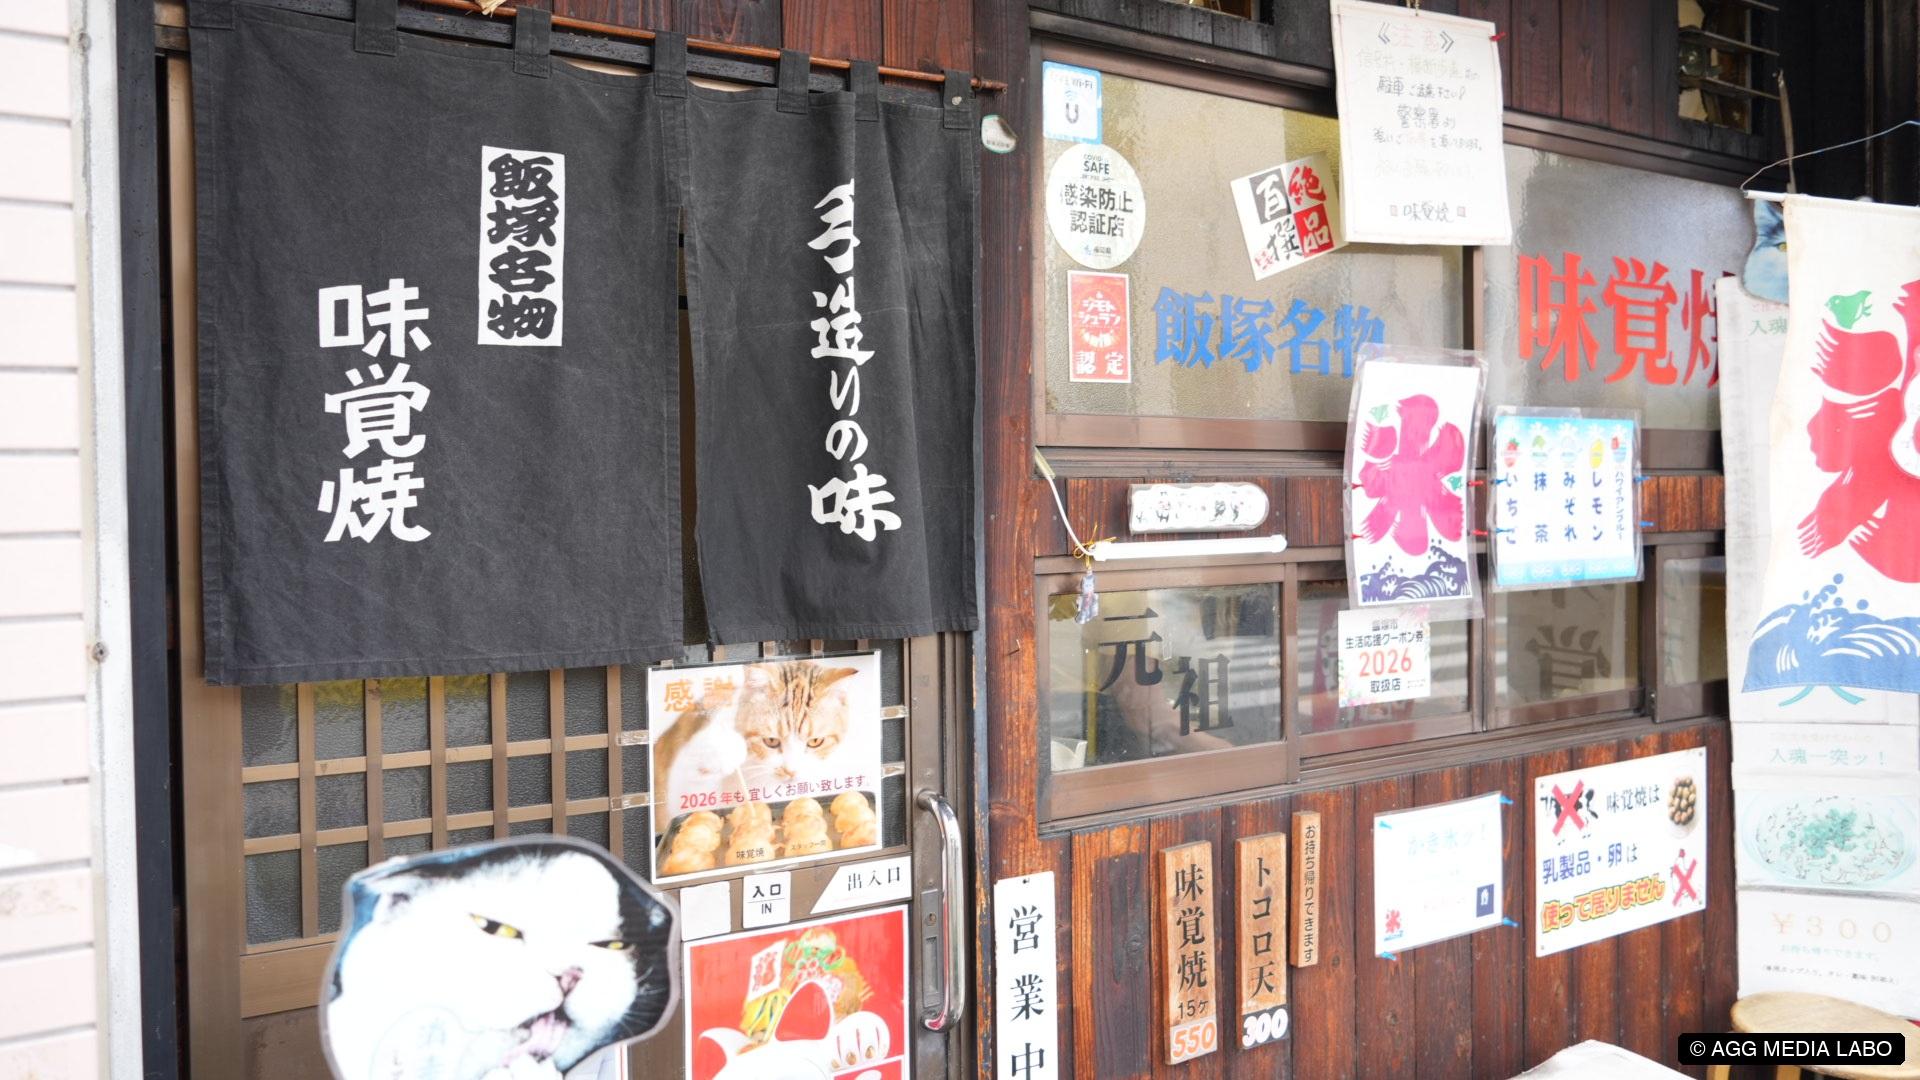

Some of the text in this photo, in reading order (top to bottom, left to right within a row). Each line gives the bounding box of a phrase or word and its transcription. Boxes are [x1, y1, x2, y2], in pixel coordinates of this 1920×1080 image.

[1083, 161, 1110, 175] SAFE
[1065, 183, 1134, 213] 感染防止
[1288, 165, 1329, 253] 絶品
[1070, 210, 1125, 238] 認証店
[487, 153, 559, 340] 飯塚名物
[1154, 286, 1385, 379] 飯塚名物
[807, 178, 902, 542] 手造りの味
[1075, 351, 1124, 375] 認定
[317, 278, 432, 543] 味覚焼
[1534, 471, 1549, 543] 抹茶
[1345, 630, 1424, 650] 生活応援クーポン券
[1097, 607, 1234, 736] 元祖
[1359, 647, 1412, 677] 2026
[1370, 678, 1401, 693] 取扱店
[752, 883, 782, 898] 入口
[847, 867, 901, 892] 出入口
[1303, 824, 1316, 962] お持ち帰りできます
[761, 903, 772, 914] IN
[1175, 863, 1208, 993] 味覚焼
[1251, 857, 1275, 999] トコロ天
[1009, 905, 1045, 1080] 営業中
[1172, 1022, 1216, 1058] 550
[1242, 1008, 1288, 1047] 300
